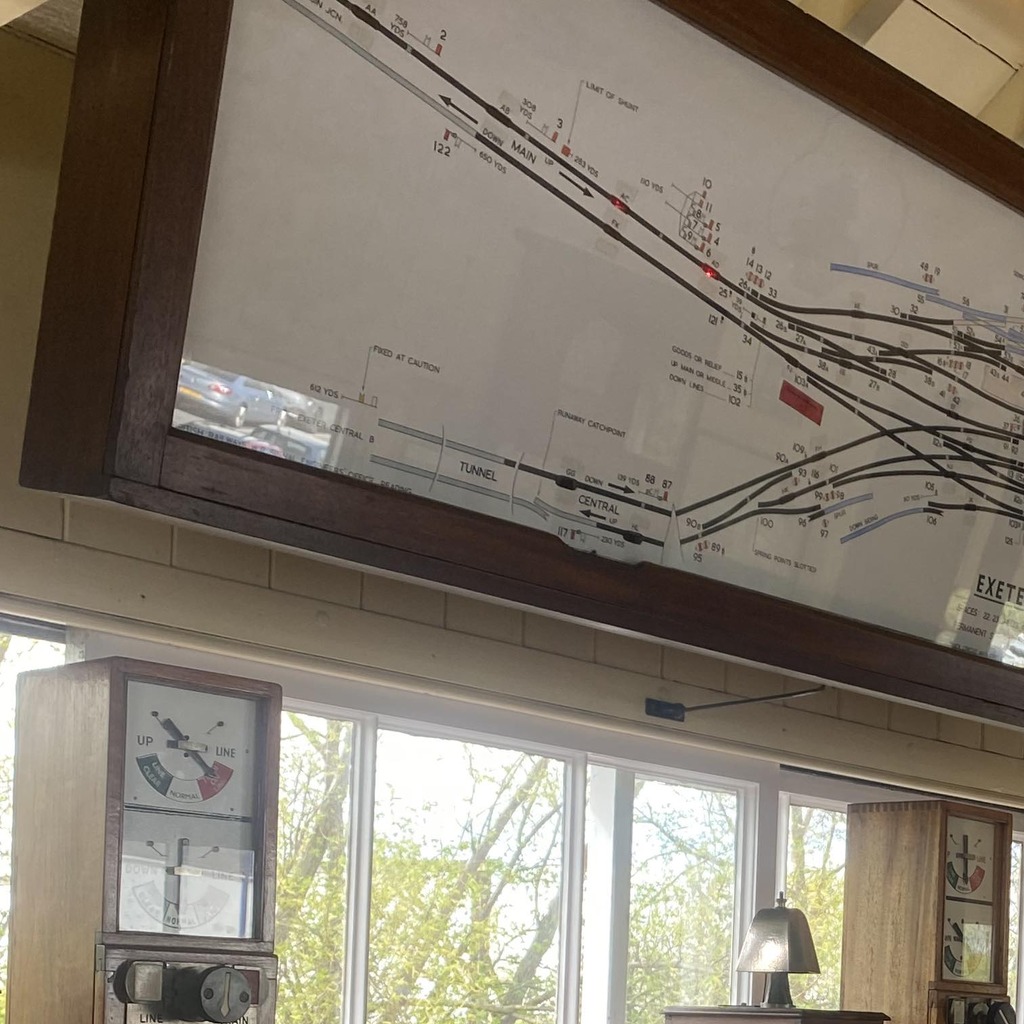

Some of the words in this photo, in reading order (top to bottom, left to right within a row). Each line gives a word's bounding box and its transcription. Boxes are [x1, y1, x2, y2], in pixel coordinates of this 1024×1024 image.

[390, 22, 405, 38] YDS
[440, 29, 447, 41] 2
[522, 98, 537, 112] 308
[519, 105, 533, 119] YDS
[556, 118, 564, 129] 3
[482, 127, 504, 146] DOWN
[433, 141, 451, 157] 122
[511, 139, 537, 164] MAIN
[479, 151, 493, 164] 650
[494, 160, 508, 174] YDS
[544, 157, 554, 166] UP
[573, 155, 586, 169] 283
[587, 164, 599, 178] YDS
[652, 182, 664, 193] YDS
[746, 258, 754, 268] 14
[756, 263, 763, 274] 13
[765, 269, 772, 280] 12
[719, 287, 727, 298] 25
[768, 287, 777, 298] 33
[909, 304, 919, 314] 32
[742, 334, 752, 345] 34
[672, 345, 692, 359] GOODS
[373, 345, 393, 358] FIXED
[396, 354, 405, 362] AT
[407, 357, 440, 373] CAUTION
[681, 364, 694, 375] MAIN
[669, 374, 686, 385] DOWN
[323, 387, 338, 398] YDS
[733, 383, 742, 394] 35
[728, 395, 741, 407] 102
[558, 409, 585, 424] RUNAWAY
[588, 420, 626, 438] CATCHPOINT
[330, 422, 363, 441] CENTRAL
[460, 461, 497, 482] TUNNEL
[585, 475, 603, 486] DOWN
[662, 480, 672, 489] 87
[578, 494, 619, 515] CENTRAL
[760, 517, 774, 529] 100
[820, 529, 829, 539] 97
[711, 542, 720, 552] 89
[693, 552, 703, 563] 95
[137, 735, 154, 746] UP
[216, 747, 236, 758] LINE
[152, 761, 166, 778] LINE
[169, 790, 199, 799] NORMAL
[125, 864, 158, 875] DOWN
[140, 1014, 163, 1024] LINE
